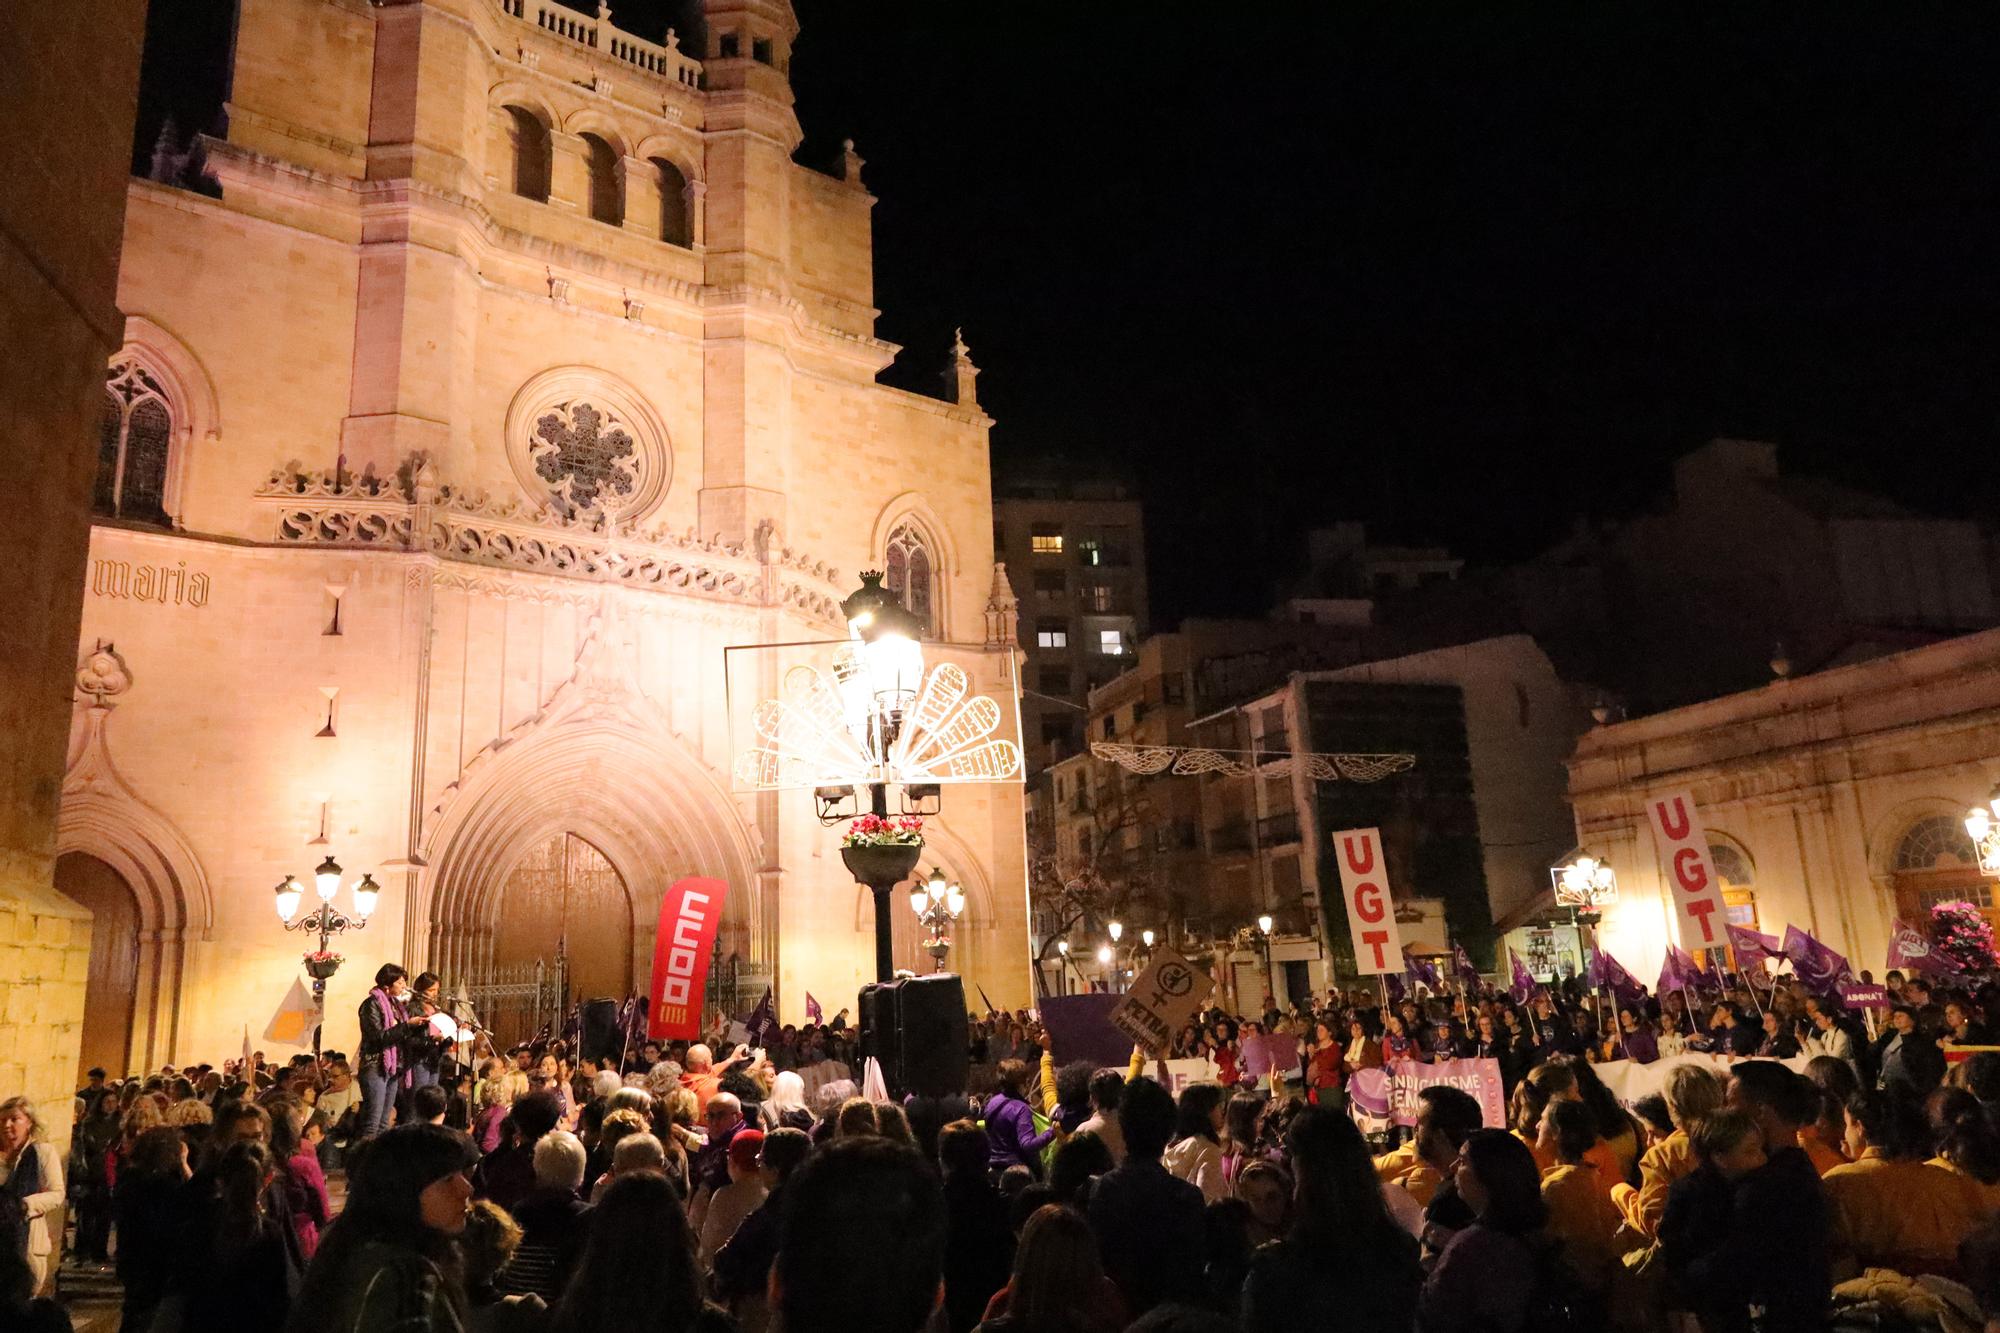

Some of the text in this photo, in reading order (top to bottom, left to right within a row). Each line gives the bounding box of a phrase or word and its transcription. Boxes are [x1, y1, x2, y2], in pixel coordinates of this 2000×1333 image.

[93, 560, 210, 607] maria
[1344, 836, 1389, 969] UGT
[1656, 797, 1715, 942] UGT
[662, 890, 709, 1005] CCOO
